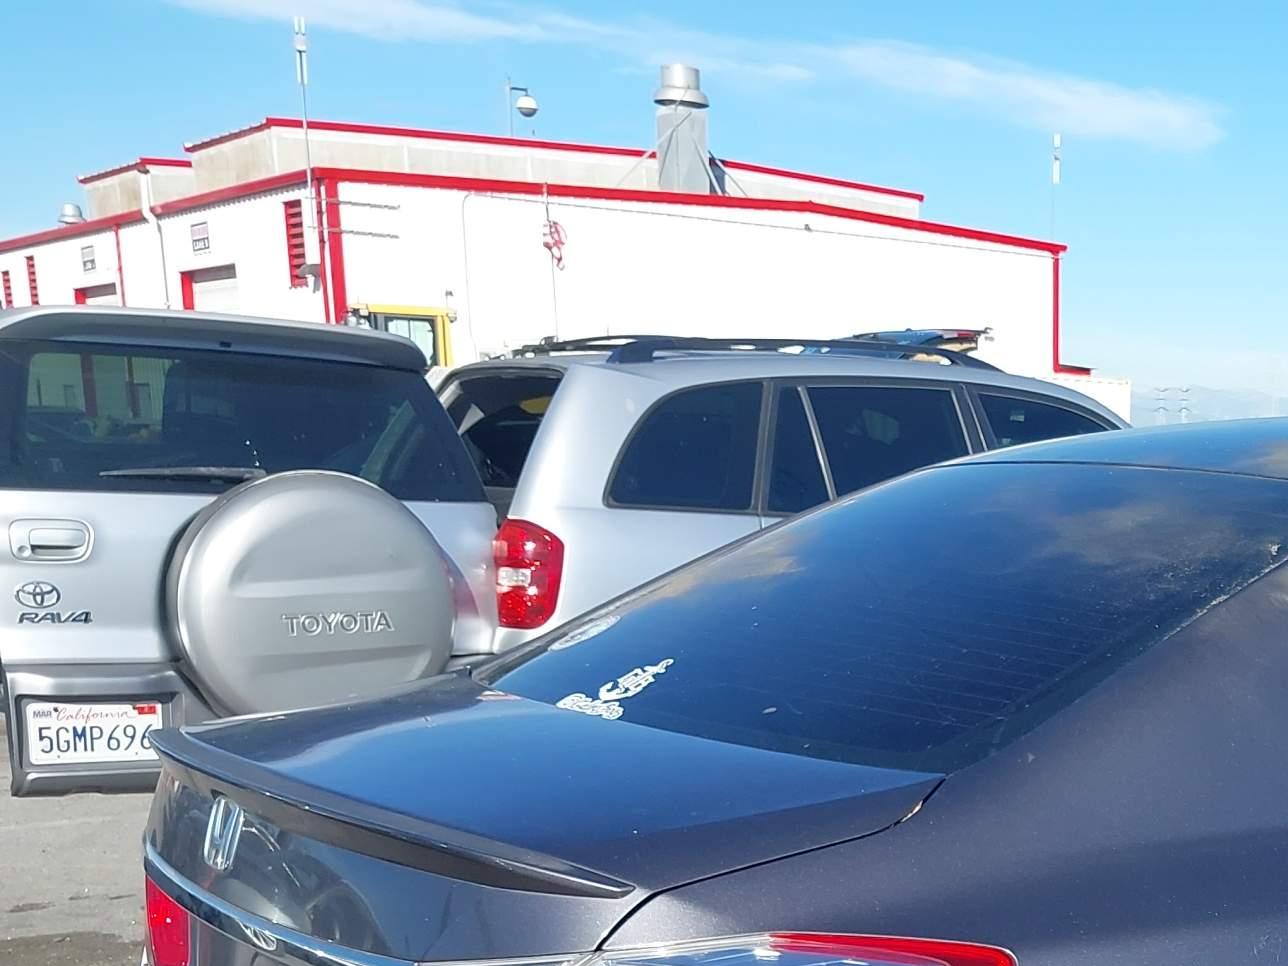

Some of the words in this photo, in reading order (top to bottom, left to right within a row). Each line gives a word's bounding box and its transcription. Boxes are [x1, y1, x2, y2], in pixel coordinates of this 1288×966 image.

[17, 611, 93, 624] RAV4
[281, 611, 395, 636] TOYOTA
[32, 710, 52, 719] MAR
[54, 706, 131, 724] California
[38, 724, 154, 754] 5GMP696
